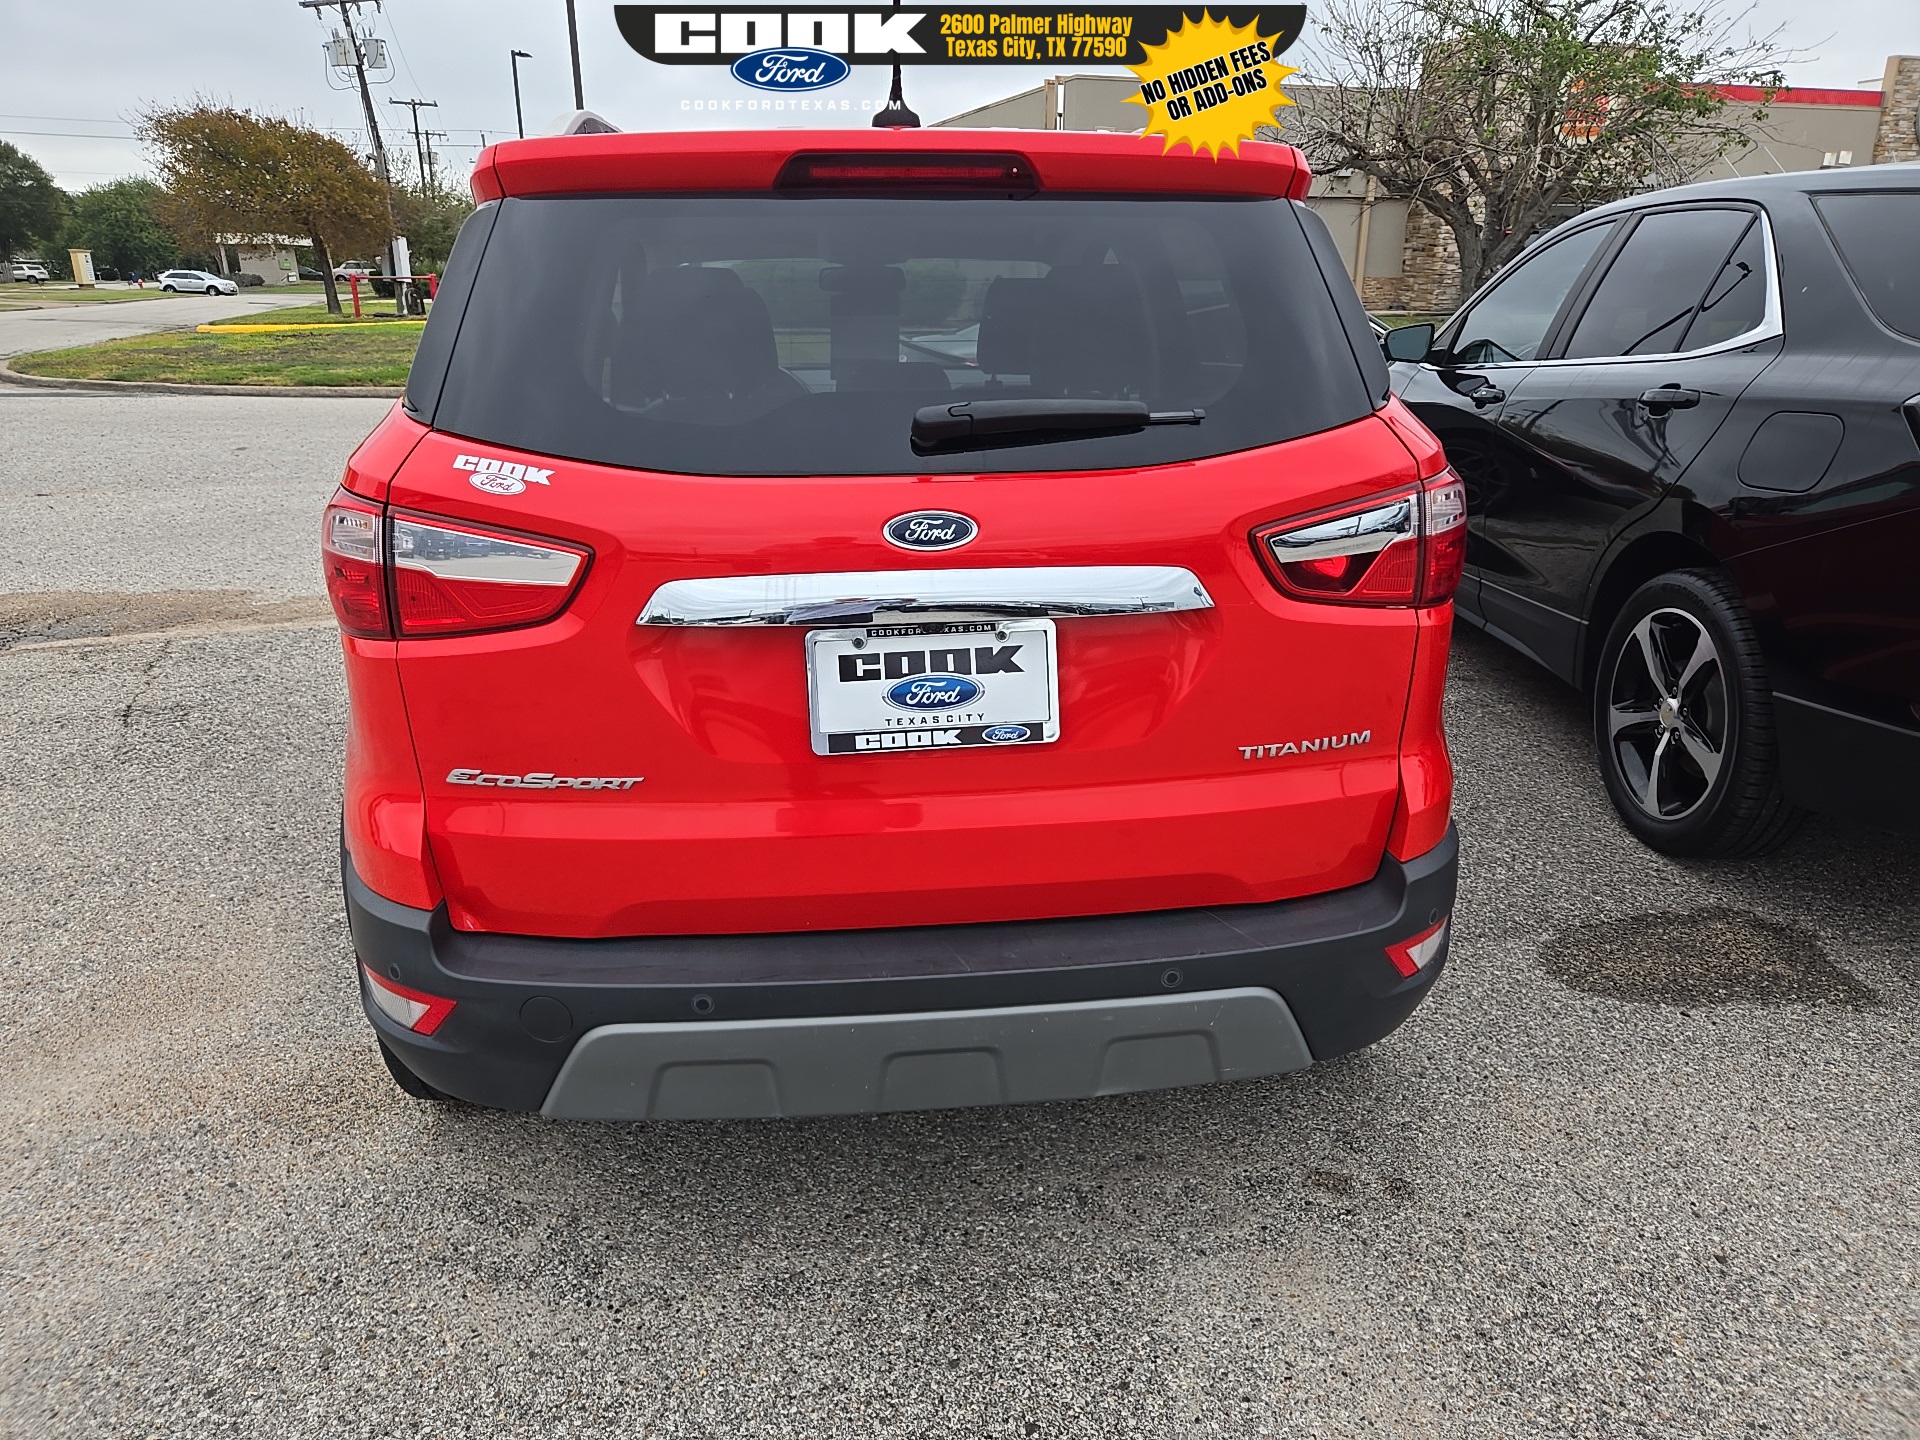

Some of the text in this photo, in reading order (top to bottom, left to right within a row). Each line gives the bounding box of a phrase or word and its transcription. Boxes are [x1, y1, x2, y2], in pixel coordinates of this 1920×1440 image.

[453, 454, 556, 486] COOK
[480, 474, 516, 492] Ford
[904, 519, 957, 542] Ford
[838, 645, 1025, 682] COOK
[905, 680, 962, 705] Ford
[885, 712, 985, 727] TEXAS CITY
[855, 729, 962, 750] COOK
[991, 726, 1019, 741] Ford
[1237, 730, 1371, 760] TITANIUM
